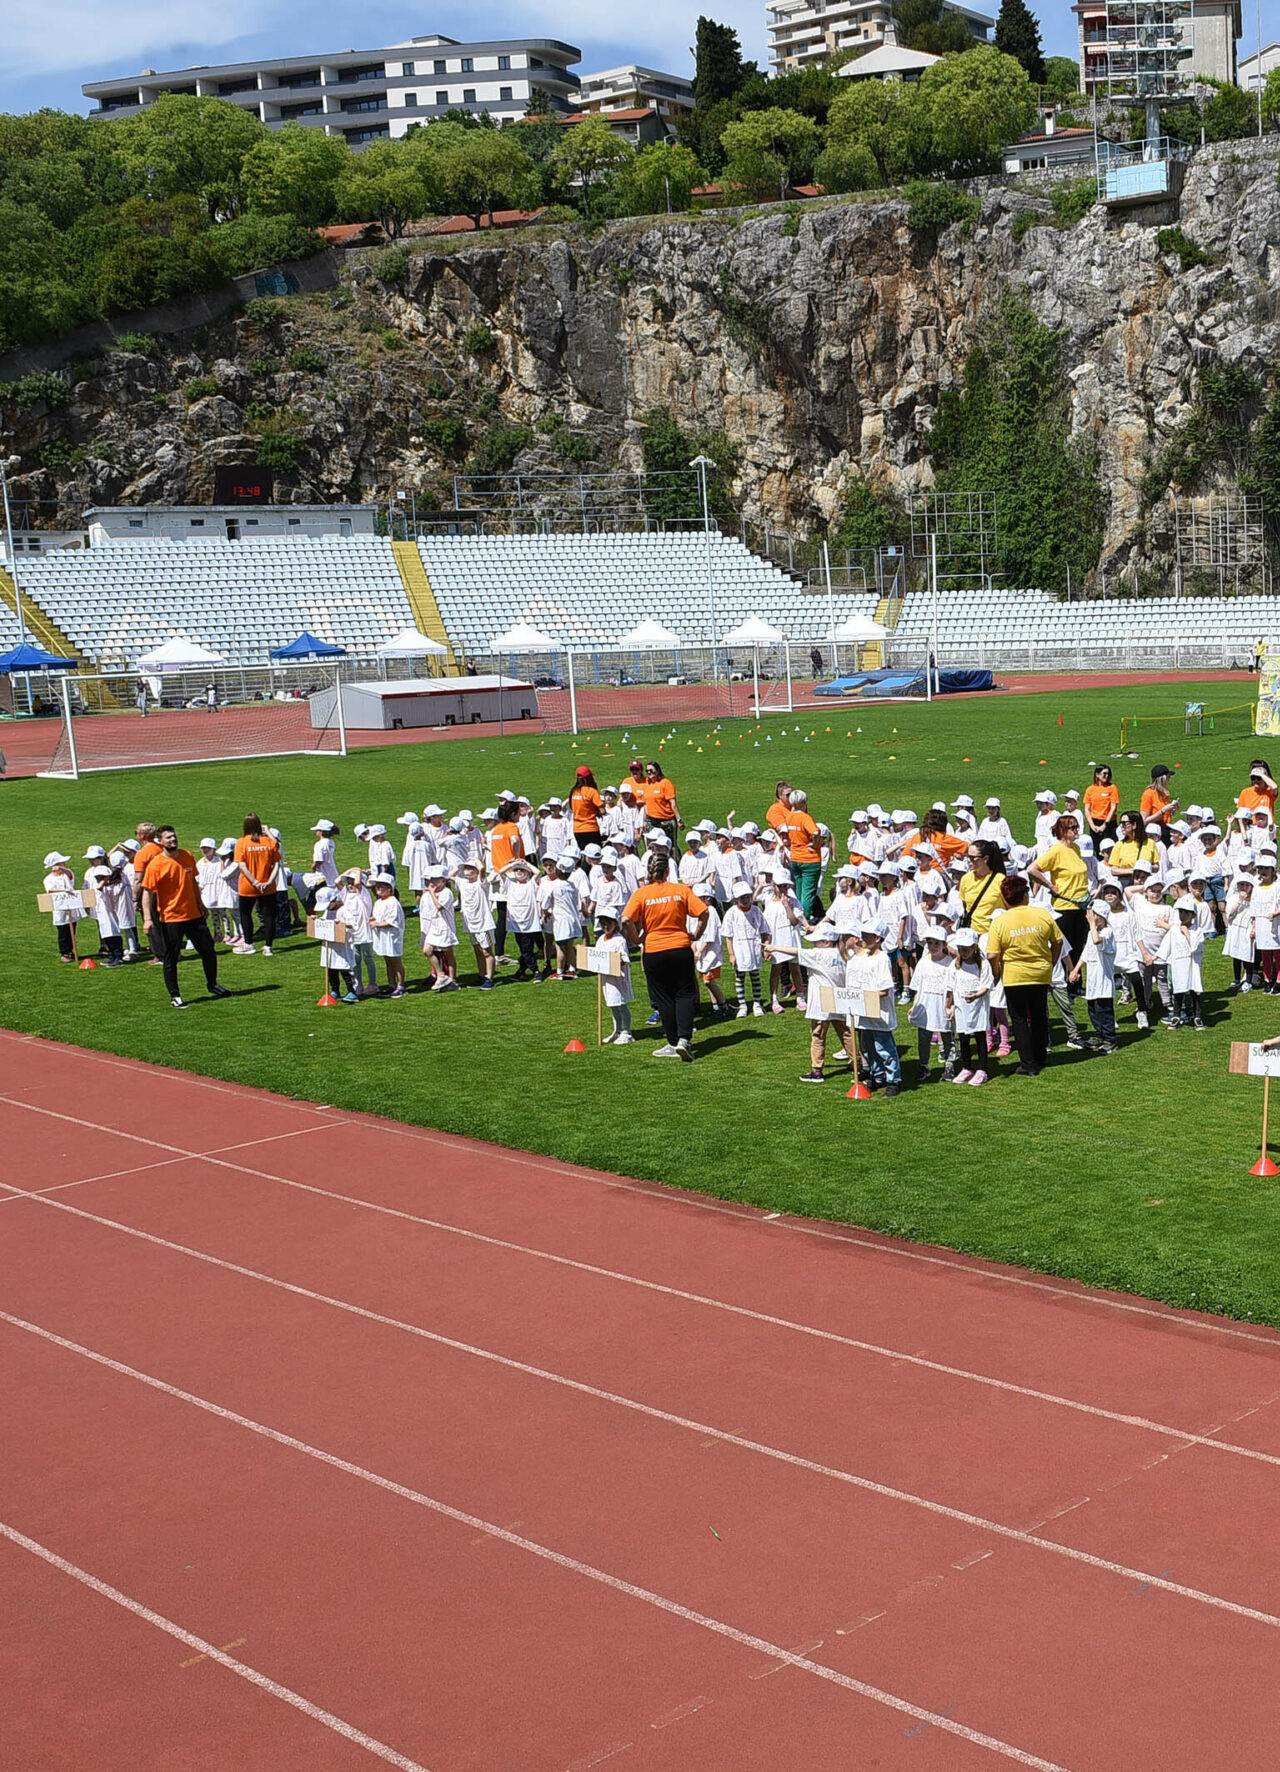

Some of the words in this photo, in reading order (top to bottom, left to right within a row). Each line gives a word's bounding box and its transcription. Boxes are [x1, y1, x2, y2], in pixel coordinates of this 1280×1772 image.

[645, 896, 672, 906] ZAMET
[589, 949, 607, 959] ZAMET
[1264, 1065, 1270, 1075] 2
